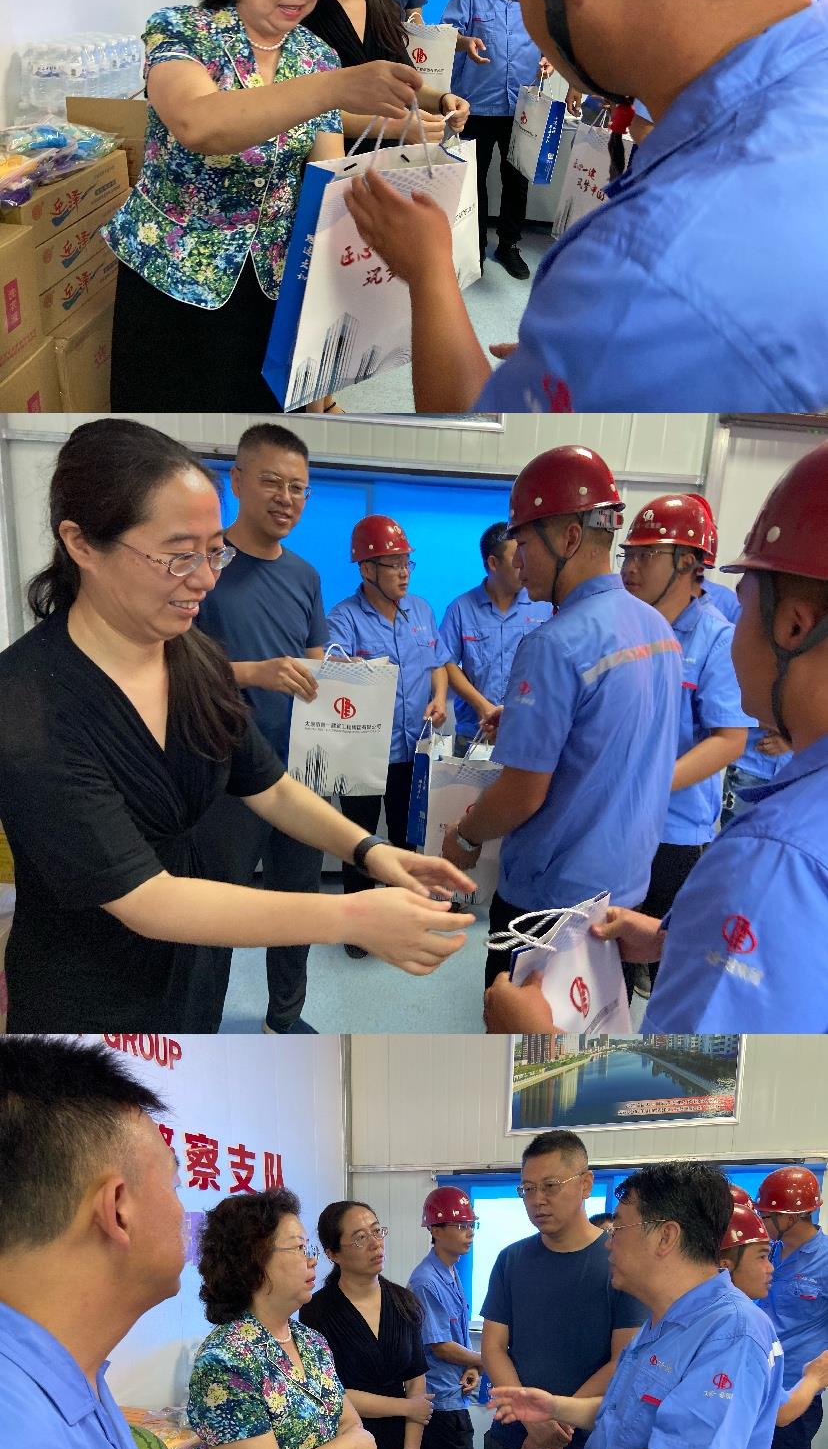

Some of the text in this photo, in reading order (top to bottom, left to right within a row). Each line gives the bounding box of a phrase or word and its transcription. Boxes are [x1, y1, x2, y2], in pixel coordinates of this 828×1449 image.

[103, 1033, 183, 1070] GROUP
[158, 1124, 285, 1195] 察支队
